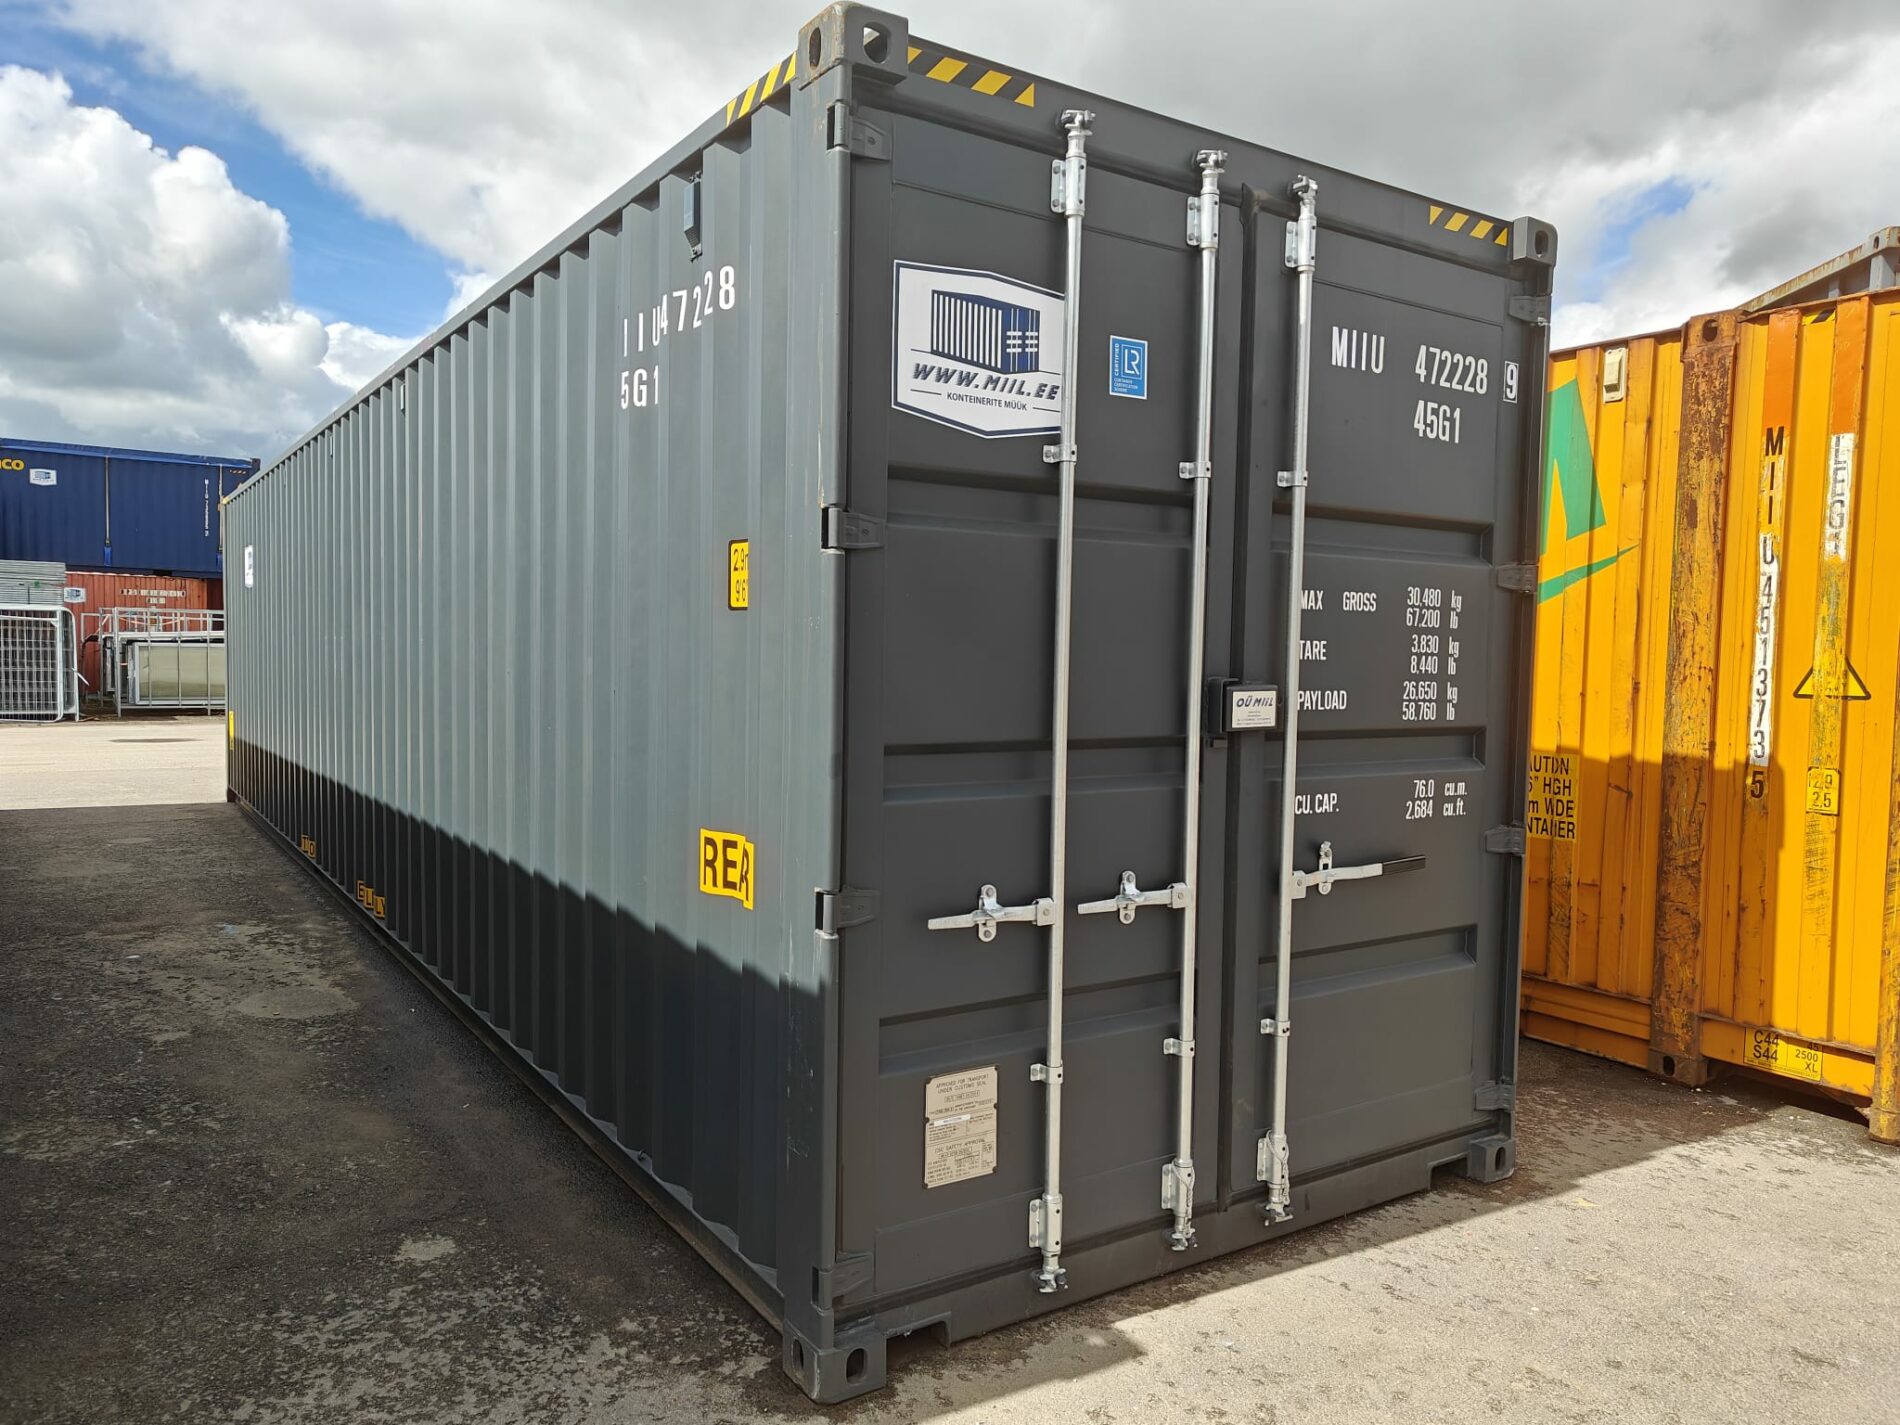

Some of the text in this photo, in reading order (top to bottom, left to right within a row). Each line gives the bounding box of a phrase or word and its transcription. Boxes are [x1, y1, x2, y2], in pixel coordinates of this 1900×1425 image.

[1331, 326, 1518, 399] MIIU 472228 9
[912, 362, 1061, 401] WWW.MIIL.EE
[946, 391, 1028, 411] KONTEINERITE MÜÜK
[1413, 400, 1461, 444] 45G1
[1342, 591, 1377, 612] GROSS
[1451, 589, 1462, 613] kg
[1449, 610, 1459, 629] lb
[1299, 640, 1328, 661] TARE
[1448, 636, 1460, 658] kg
[1447, 656, 1457, 675] lb
[1297, 689, 1347, 711] PAYLOAD
[1446, 681, 1458, 704] kg
[1446, 702, 1455, 721] lb
[1413, 779, 1435, 799] 76.0
[1754, 1030, 1779, 1047] C44
[1753, 1044, 1778, 1062] S44
[1795, 1049, 1819, 1062] 2500
[1804, 1061, 1818, 1073] XL
